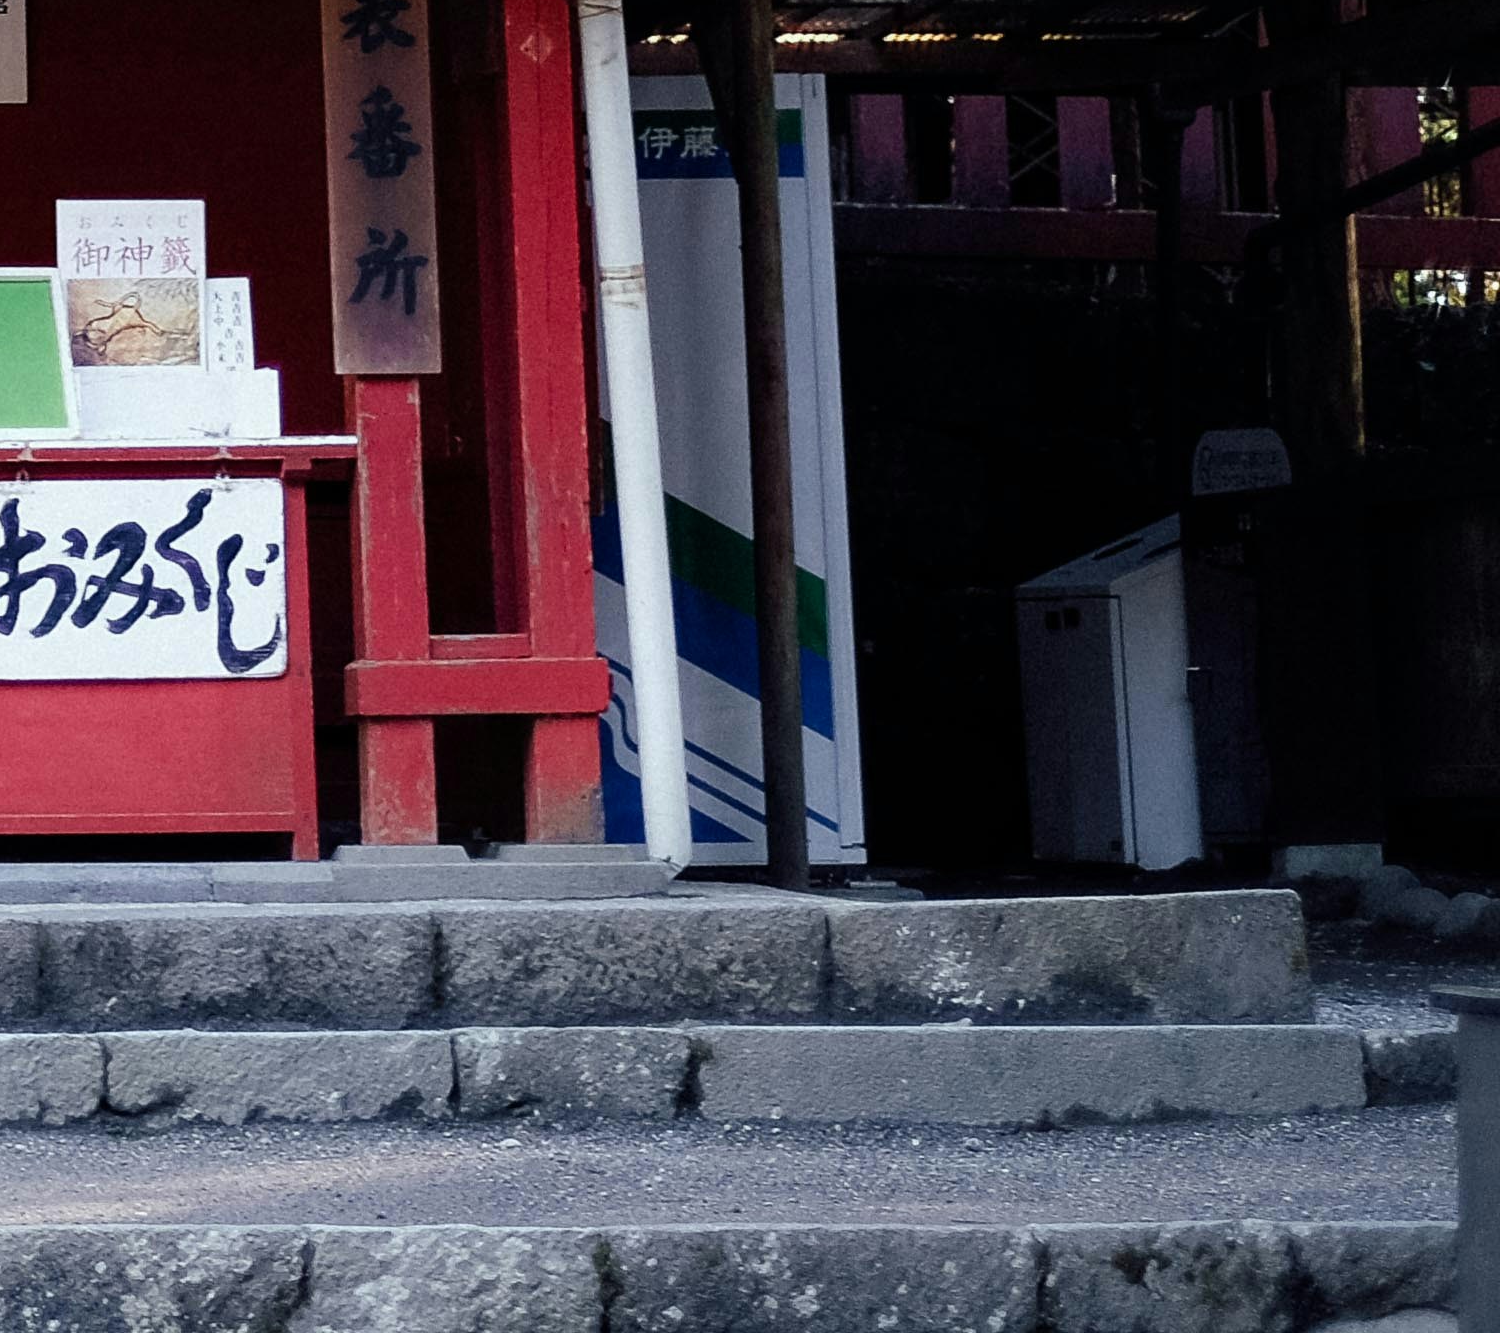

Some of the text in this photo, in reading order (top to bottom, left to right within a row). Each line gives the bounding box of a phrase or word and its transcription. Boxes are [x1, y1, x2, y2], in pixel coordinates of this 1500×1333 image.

[638, 125, 729, 160] 伊藤
[72, 235, 198, 277] 御神籤
